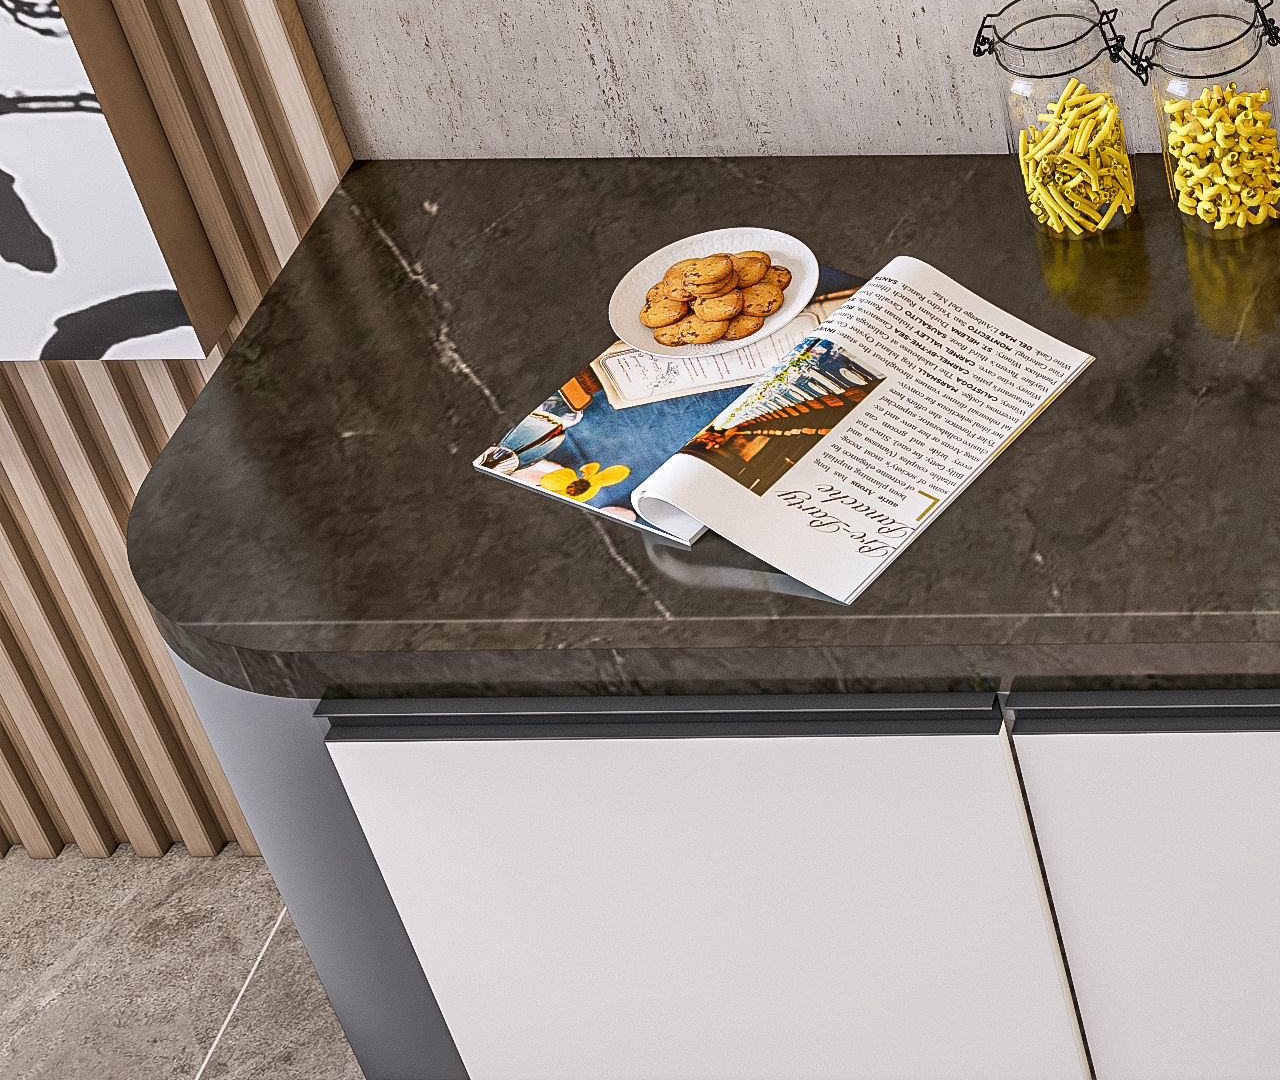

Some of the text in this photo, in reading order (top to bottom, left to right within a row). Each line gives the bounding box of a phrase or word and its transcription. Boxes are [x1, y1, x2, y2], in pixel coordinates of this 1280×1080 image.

[904, 310, 948, 339] SAUSALITO
[950, 326, 981, 346] HELENA
[913, 329, 943, 350] VALLEY
[967, 325, 1013, 352] MONTECITO
[871, 351, 914, 380] throughout
[945, 346, 976, 367] CARMEL
[918, 366, 960, 393] MARSHALL
[956, 376, 999, 402] CALISTOGA
[813, 458, 831, 473] long
[822, 451, 854, 471] nuptials
[850, 480, 876, 496] Arons
[853, 467, 890, 490] planning
[816, 484, 915, 538] Panache
[776, 490, 896, 557] Pre-Party
